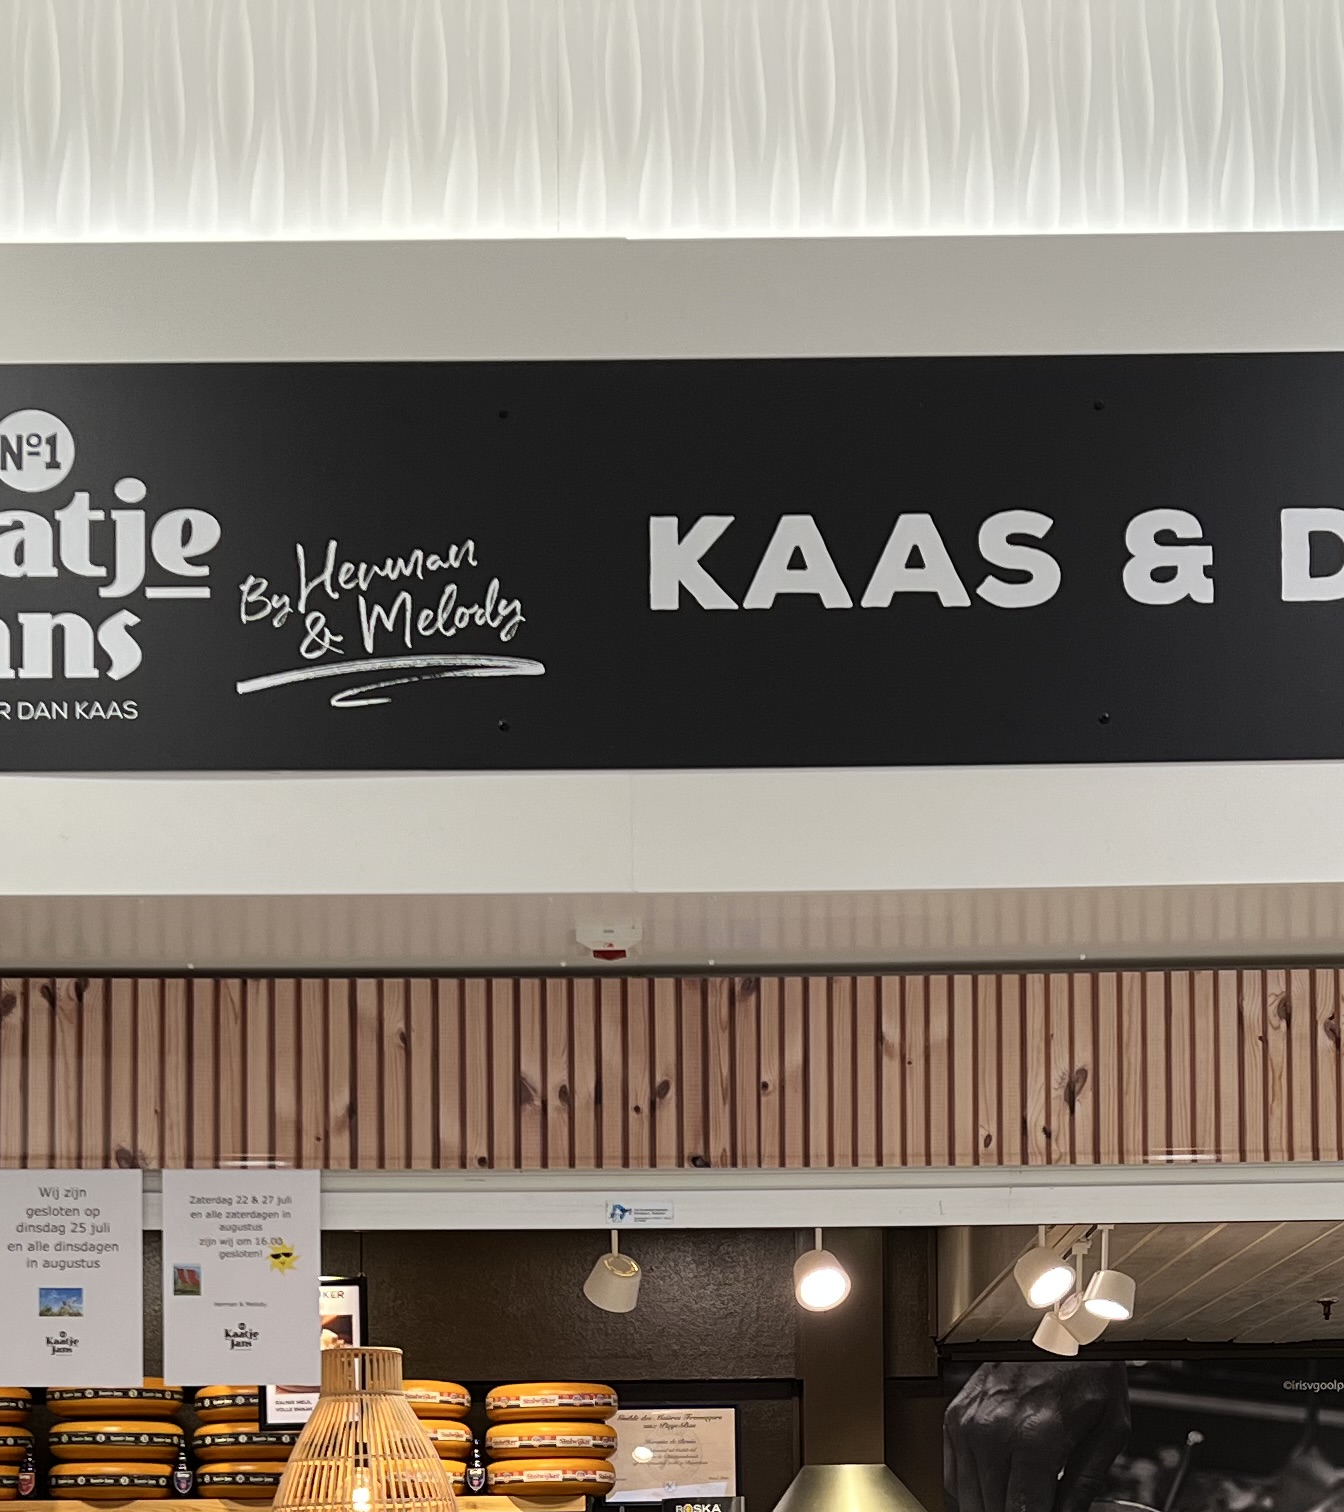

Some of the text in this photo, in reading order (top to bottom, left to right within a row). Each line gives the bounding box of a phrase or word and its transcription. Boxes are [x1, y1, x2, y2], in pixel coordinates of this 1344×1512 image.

[650, 512, 1062, 612] KAAS
[1124, 507, 1215, 605] &
[240, 539, 478, 628] By Herman
[299, 577, 526, 660] & Melody
[17, 701, 68, 720] DAN
[74, 700, 139, 720] KAAS
[38, 1186, 87, 1200] Wij zijn
[189, 1195, 233, 1205] Zaterdag
[236, 1196, 249, 1204] 22
[262, 1196, 275, 1204] 27
[276, 1195, 293, 1205] juli
[26, 1206, 101, 1218] gesloten op
[190, 1210, 291, 1220] en alle zaterdagen in
[16, 1222, 111, 1235] dinsdag 25 juli
[219, 1224, 263, 1233] augustus
[7, 1241, 120, 1254] en alle dinsdagen
[199, 1238, 217, 1247] zijn
[236, 1238, 252, 1246] om
[219, 1250, 263, 1260] gesloten!
[26, 1258, 101, 1271] in augustus
